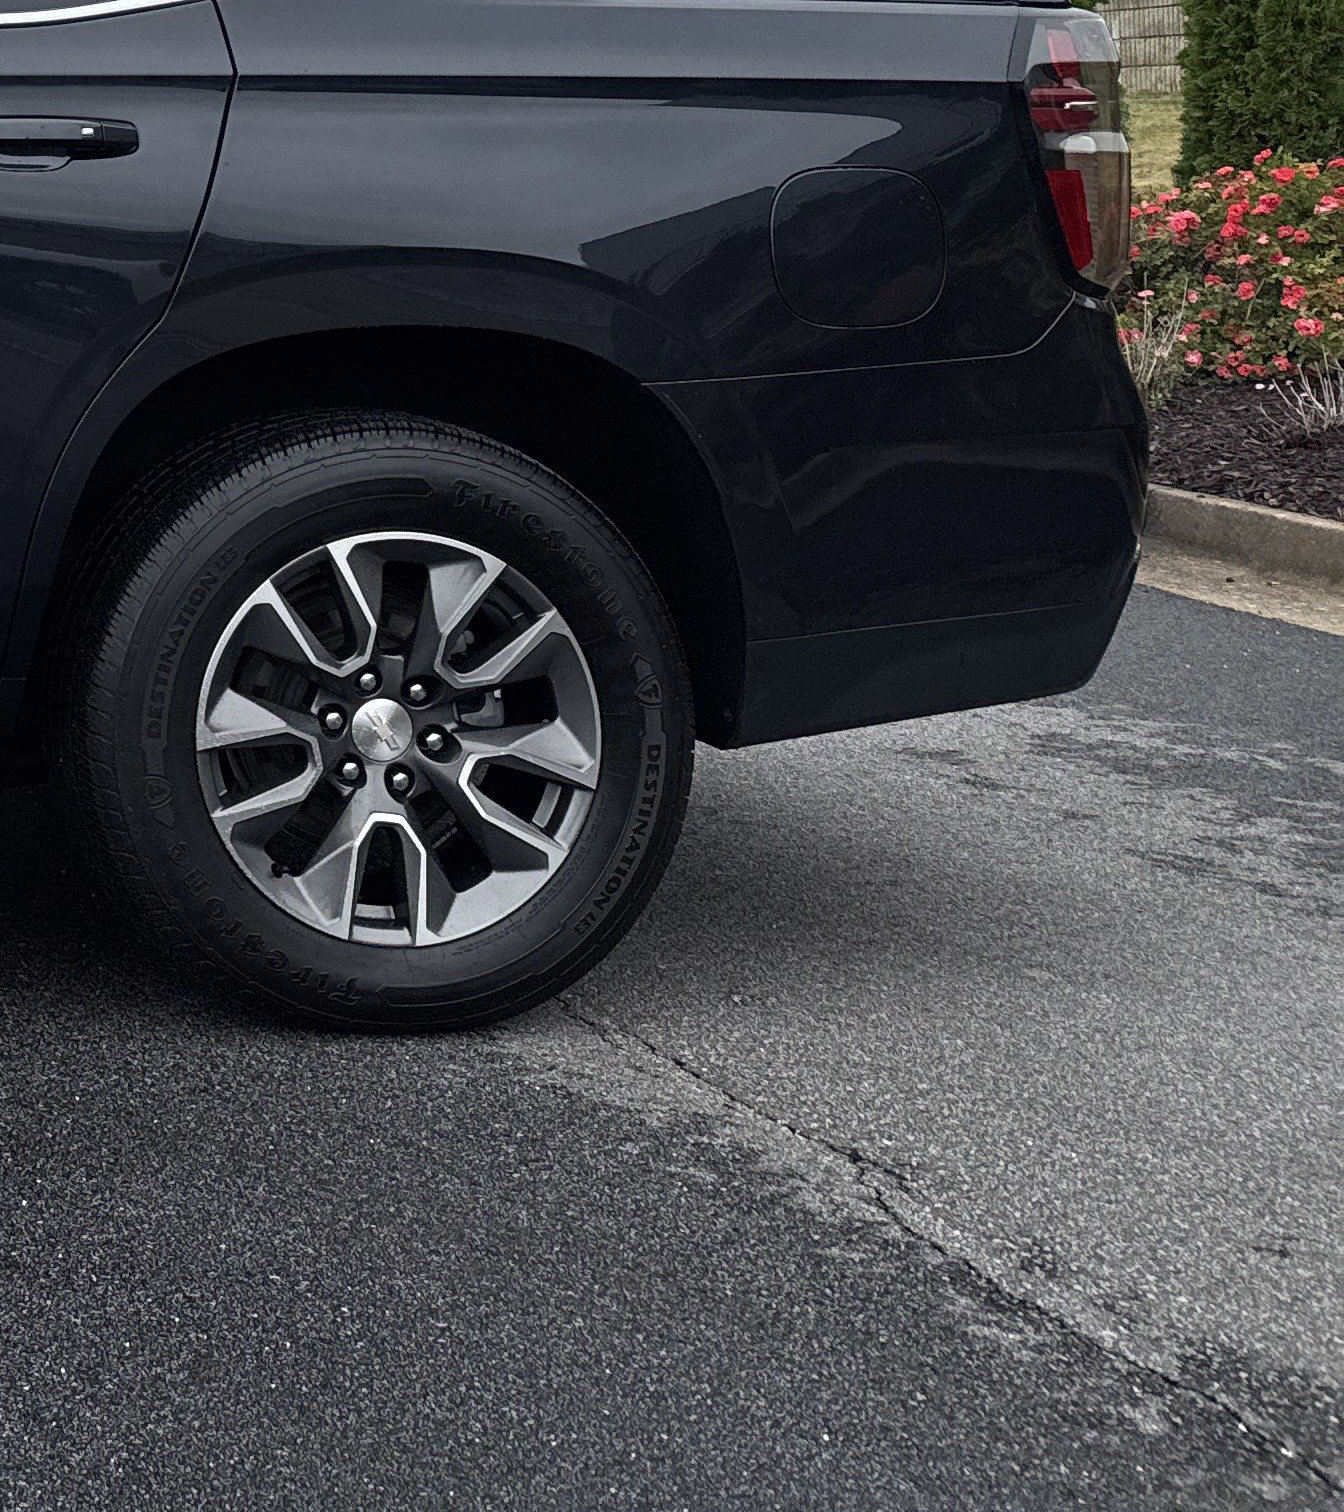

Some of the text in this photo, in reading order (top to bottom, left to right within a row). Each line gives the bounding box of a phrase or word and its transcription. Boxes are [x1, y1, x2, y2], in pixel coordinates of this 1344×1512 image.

[452, 478, 639, 641] Firestone
[147, 571, 219, 738] DESTINATION
[593, 744, 662, 911] DESTINATION
